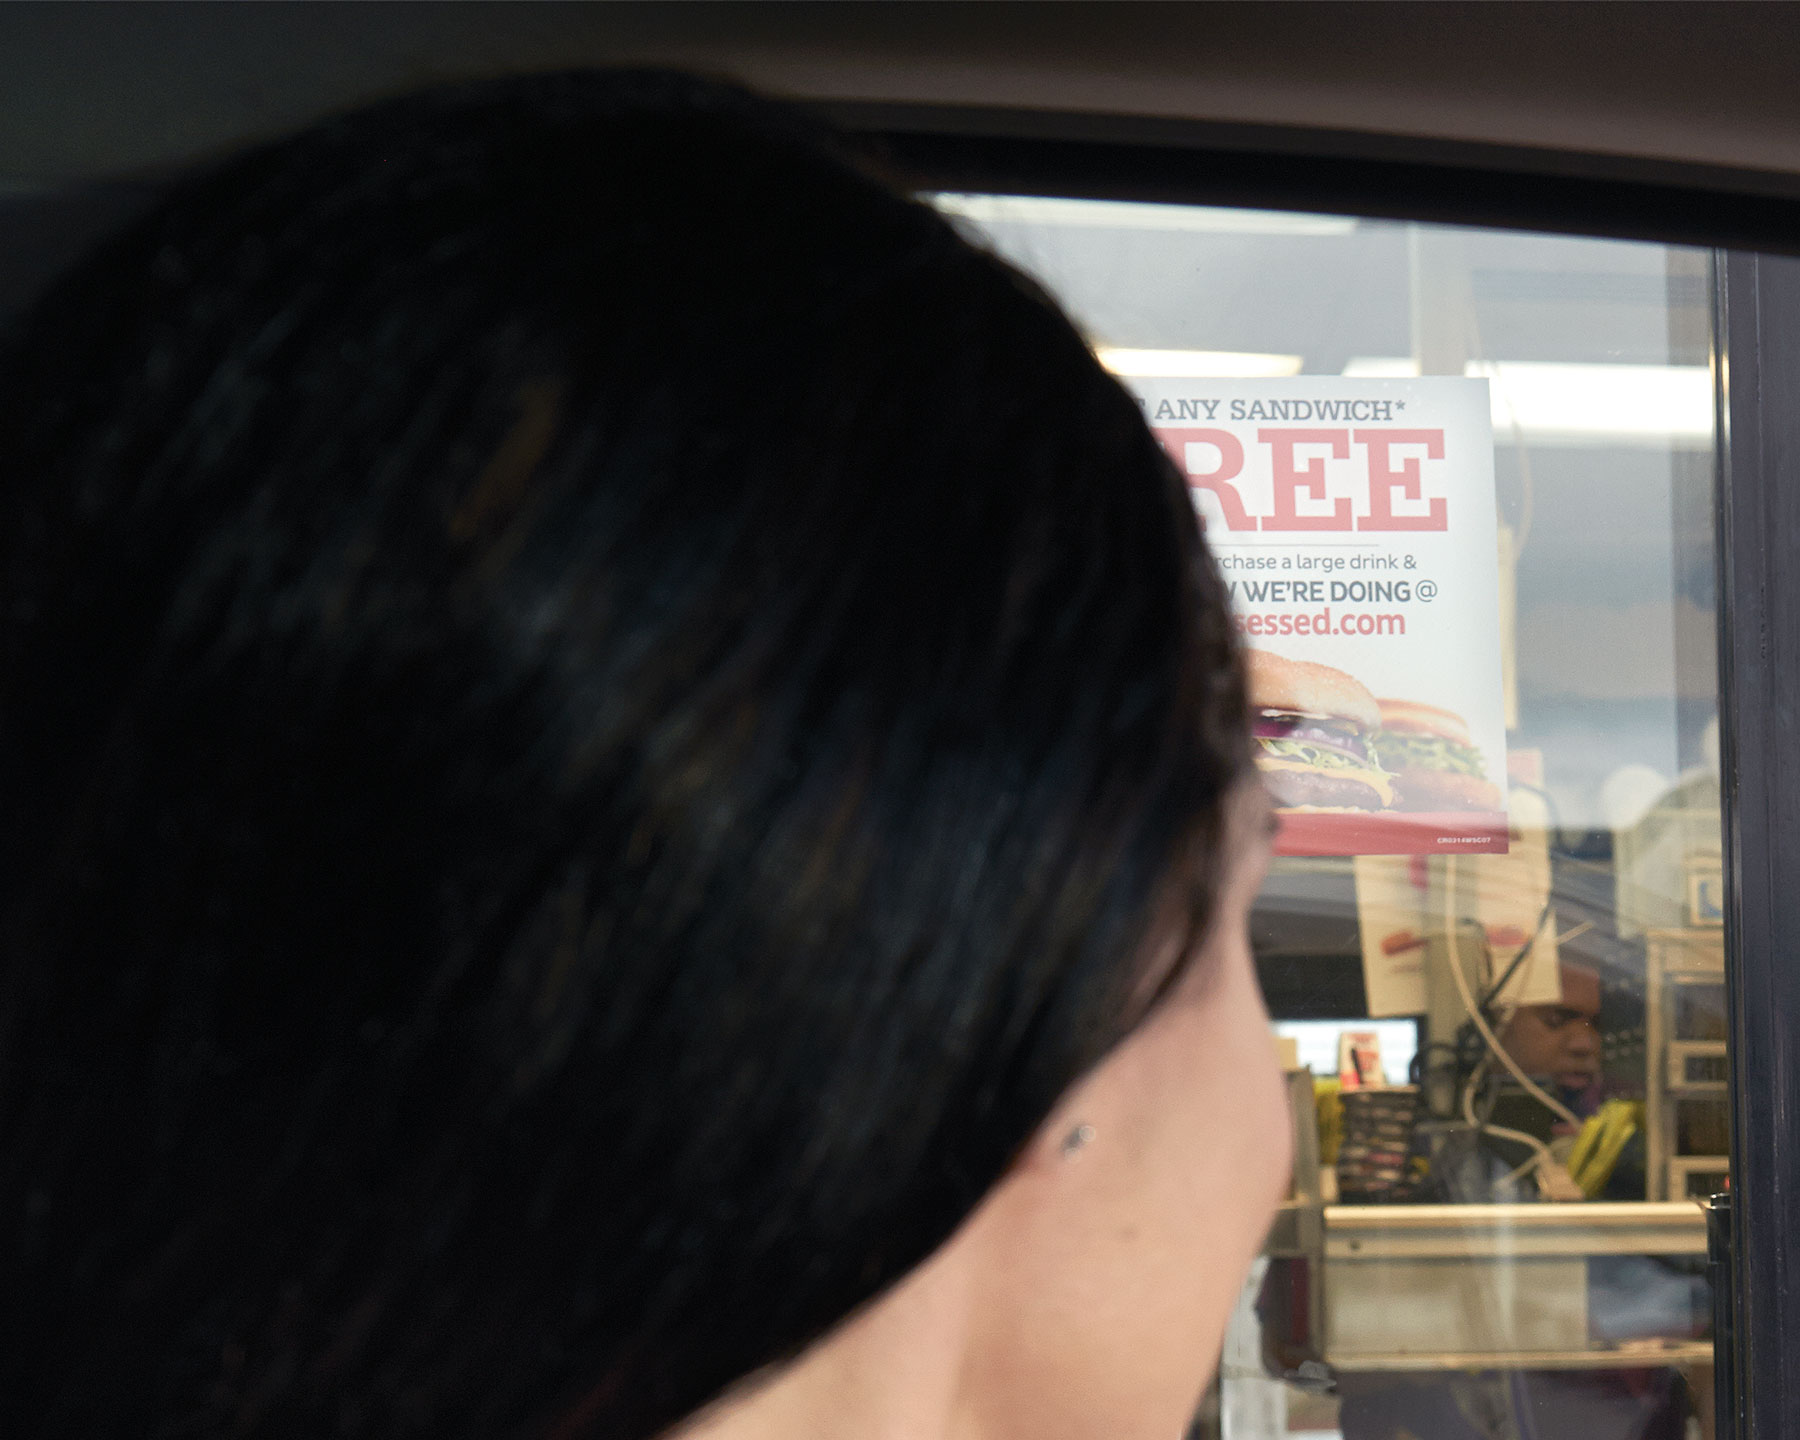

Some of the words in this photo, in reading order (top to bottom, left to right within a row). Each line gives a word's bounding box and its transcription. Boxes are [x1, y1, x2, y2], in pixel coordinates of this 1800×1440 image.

[1154, 398, 1221, 420] ANY
[1150, 427, 1448, 532] REE
[1217, 553, 1277, 570] rchase
[1281, 557, 1292, 570] a
[1296, 553, 1345, 574] large
[1349, 553, 1399, 570] drink
[1403, 554, 1418, 570] &
[1242, 580, 1324, 602] WE'RE
[1330, 580, 1412, 603] DOING
[1415, 579, 1438, 603] @
[1233, 607, 1407, 636] sessed.com
